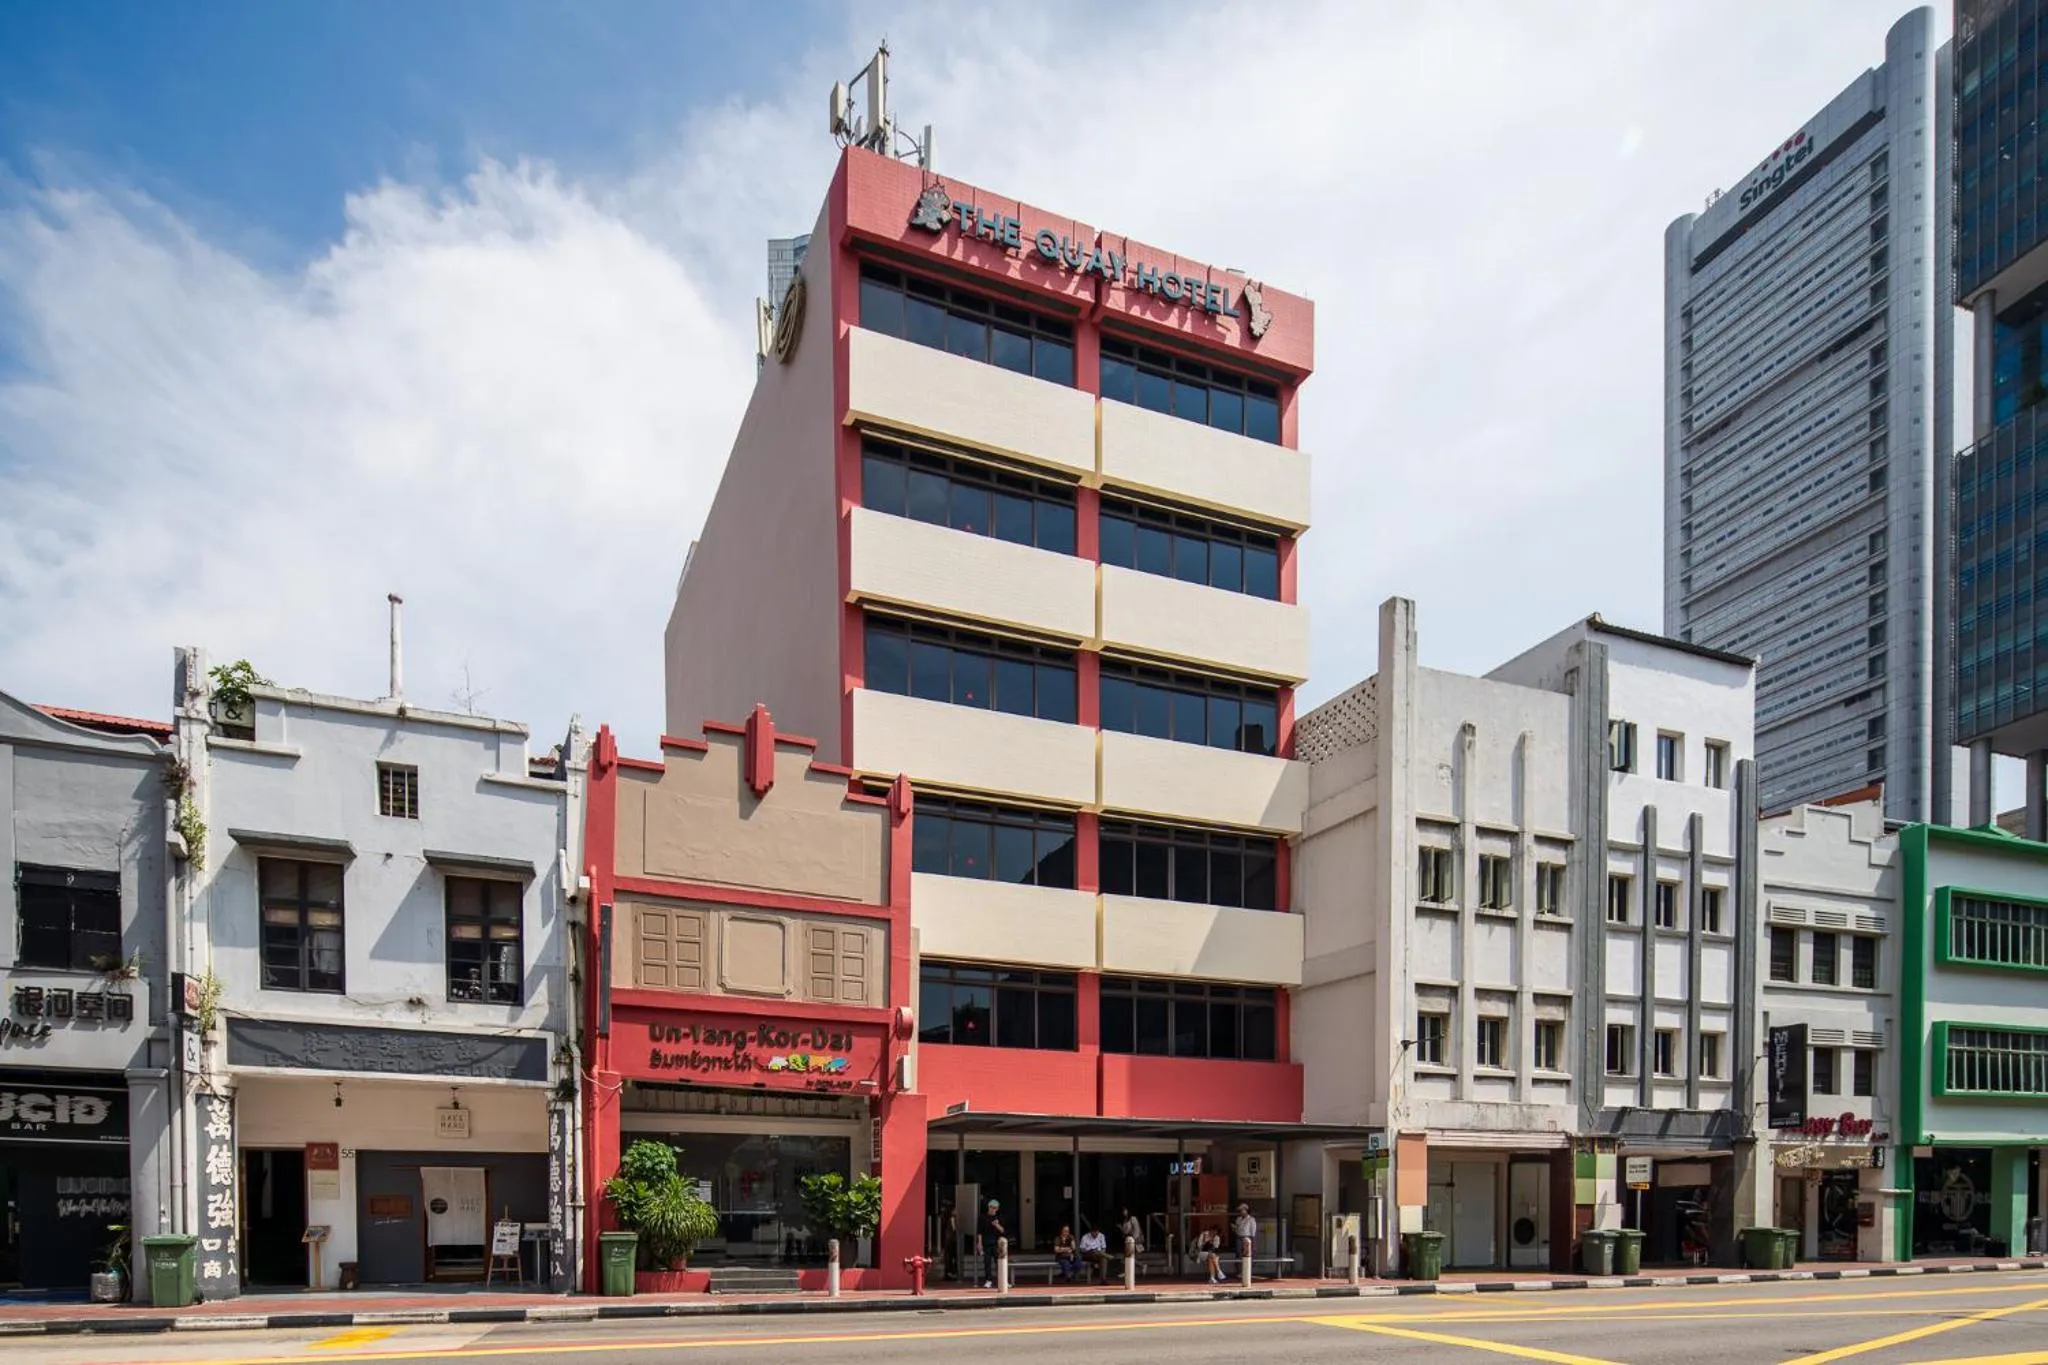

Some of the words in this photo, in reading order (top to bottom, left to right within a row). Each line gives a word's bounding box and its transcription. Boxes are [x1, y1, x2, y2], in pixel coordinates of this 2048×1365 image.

[1740, 136, 1814, 211] Singtel
[952, 201, 1022, 249] THE
[1035, 228, 1127, 282] QUAY
[1137, 262, 1241, 318] HOTEL
[11, 1122, 47, 1131] BAR
